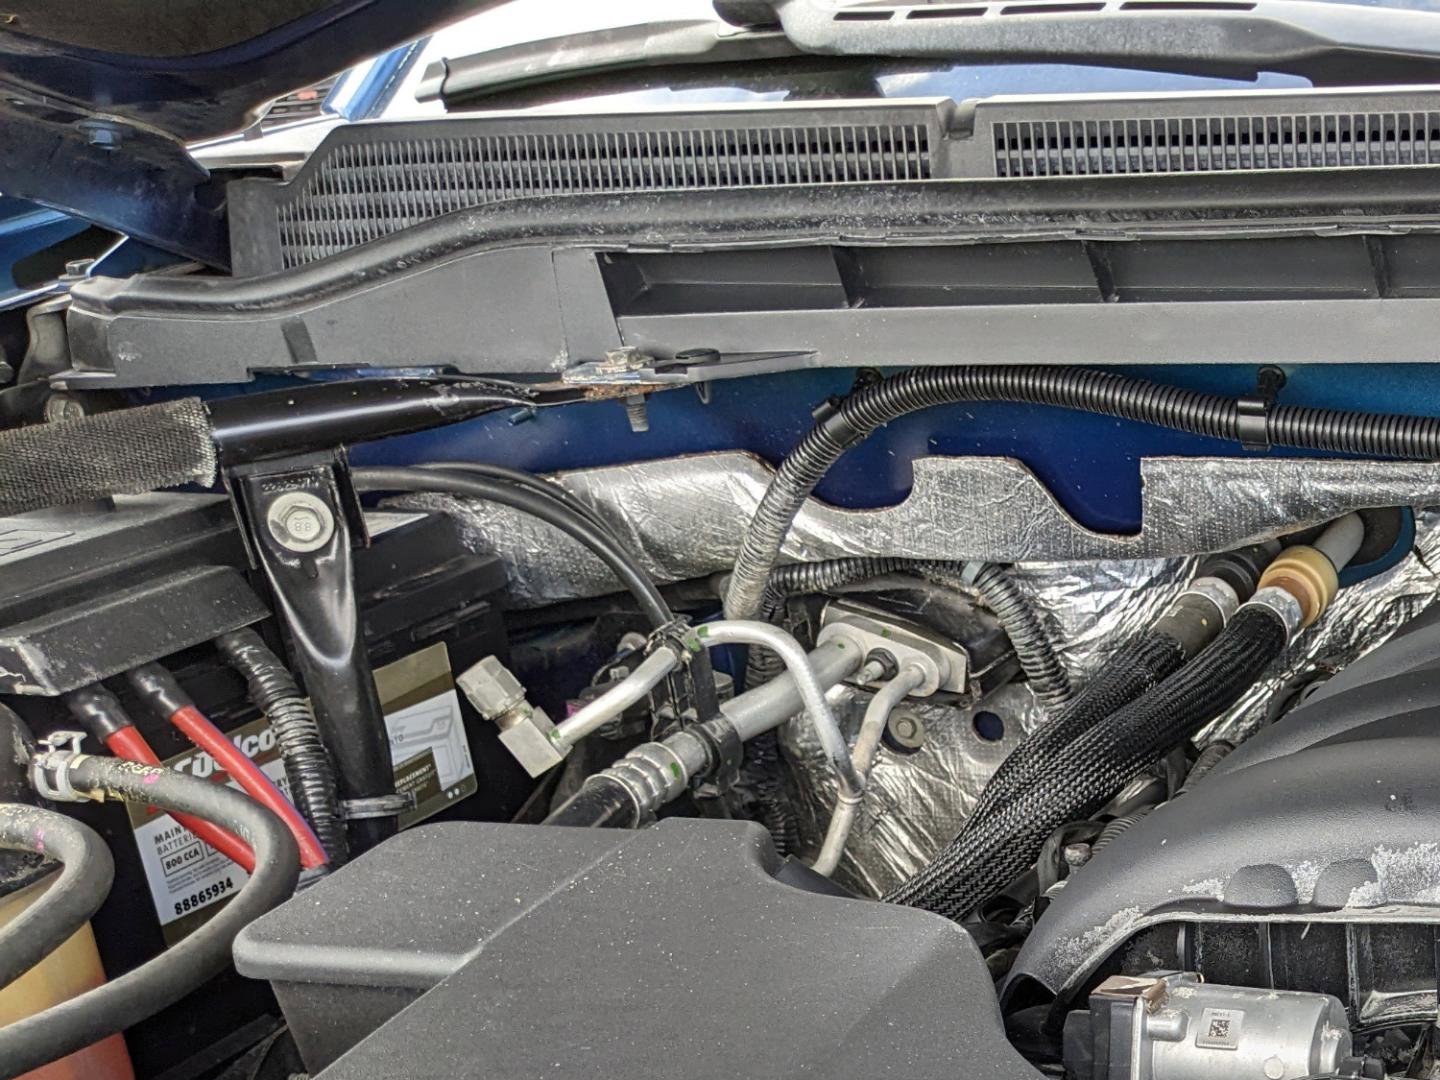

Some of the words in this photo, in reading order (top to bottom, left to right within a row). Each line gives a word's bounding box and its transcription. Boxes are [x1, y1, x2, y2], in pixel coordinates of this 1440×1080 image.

[165, 856, 183, 870] 800
[184, 848, 200, 861] CCA
[174, 876, 234, 916] 88865934
